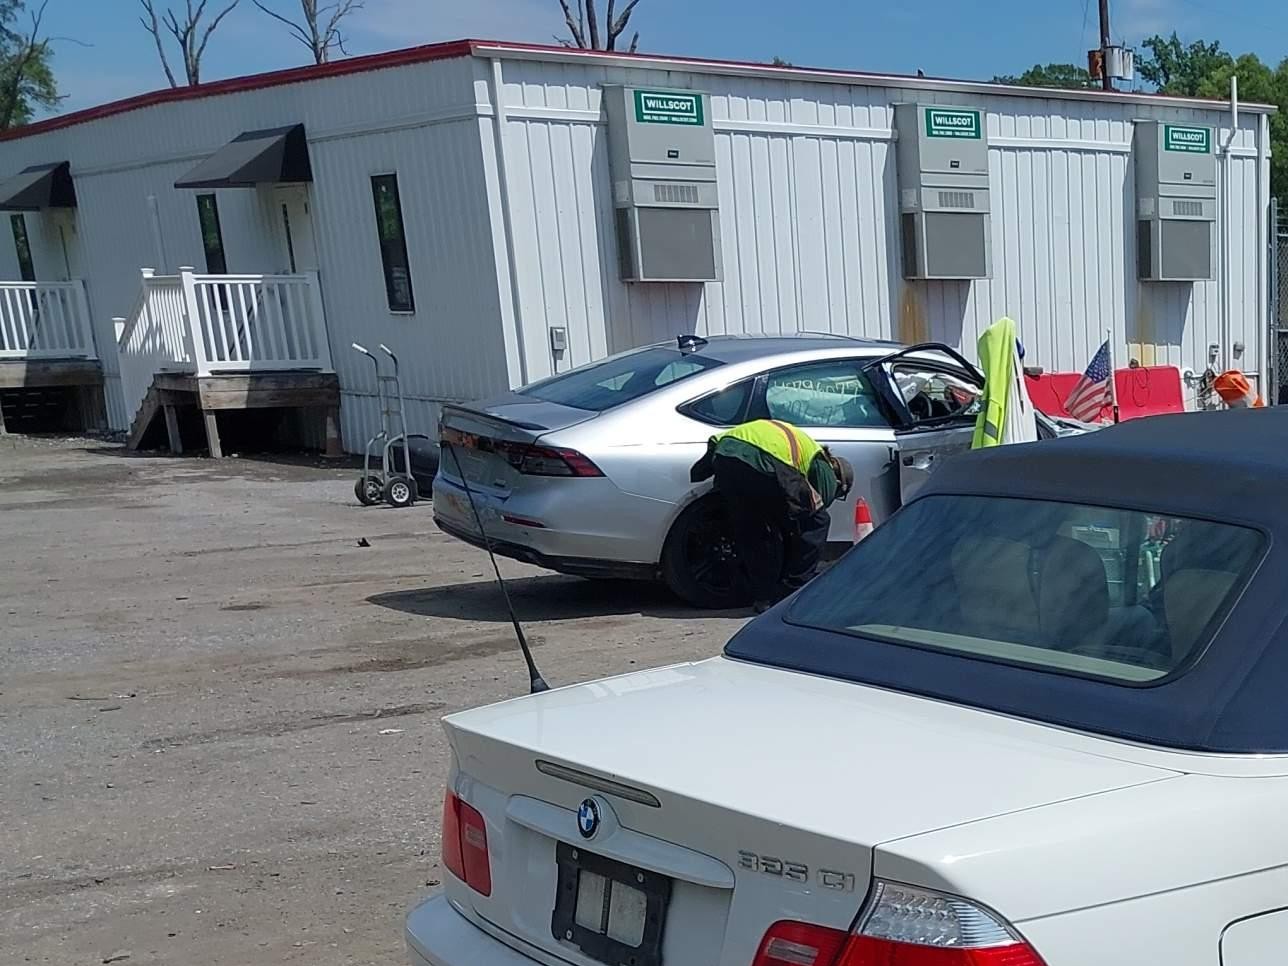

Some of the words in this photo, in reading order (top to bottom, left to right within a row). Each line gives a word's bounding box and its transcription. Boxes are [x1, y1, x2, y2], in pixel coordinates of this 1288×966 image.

[646, 99, 692, 111] WILLSCOT
[935, 115, 972, 126] WILLSCOT
[1172, 131, 1203, 142] WILLSCOT
[738, 849, 809, 885] 325
